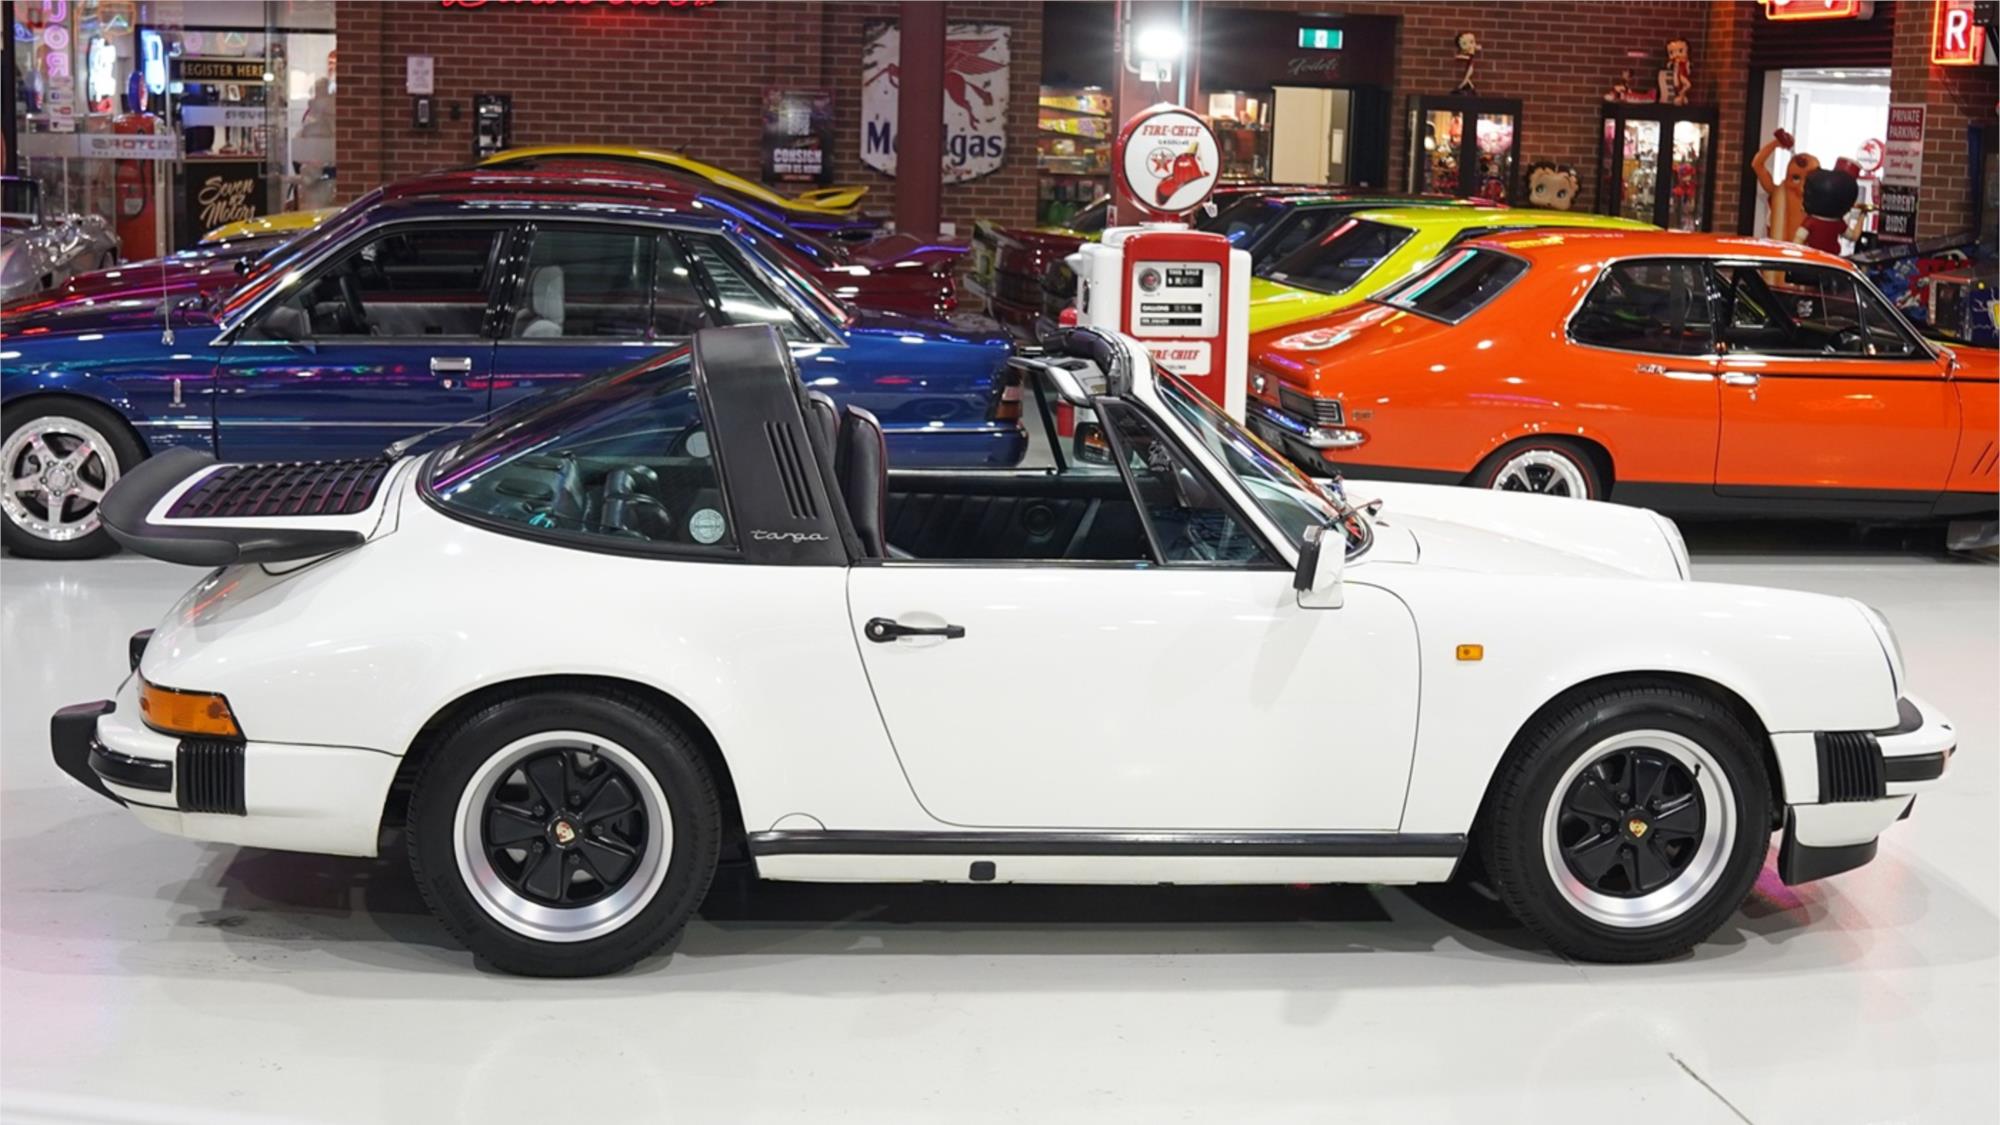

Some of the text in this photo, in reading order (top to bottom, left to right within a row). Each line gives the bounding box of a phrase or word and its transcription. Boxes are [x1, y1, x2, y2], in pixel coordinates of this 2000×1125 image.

[1945, 10, 1967, 50] R
[181, 63, 264, 77] REGISTER HERE
[1891, 109, 1921, 124] PRIVATE
[1889, 125, 1921, 139] PARKING
[773, 148, 822, 163] CONSIGN
[199, 176, 254, 205] Seven
[200, 201, 256, 229] Motors
[750, 528, 829, 544] targa
